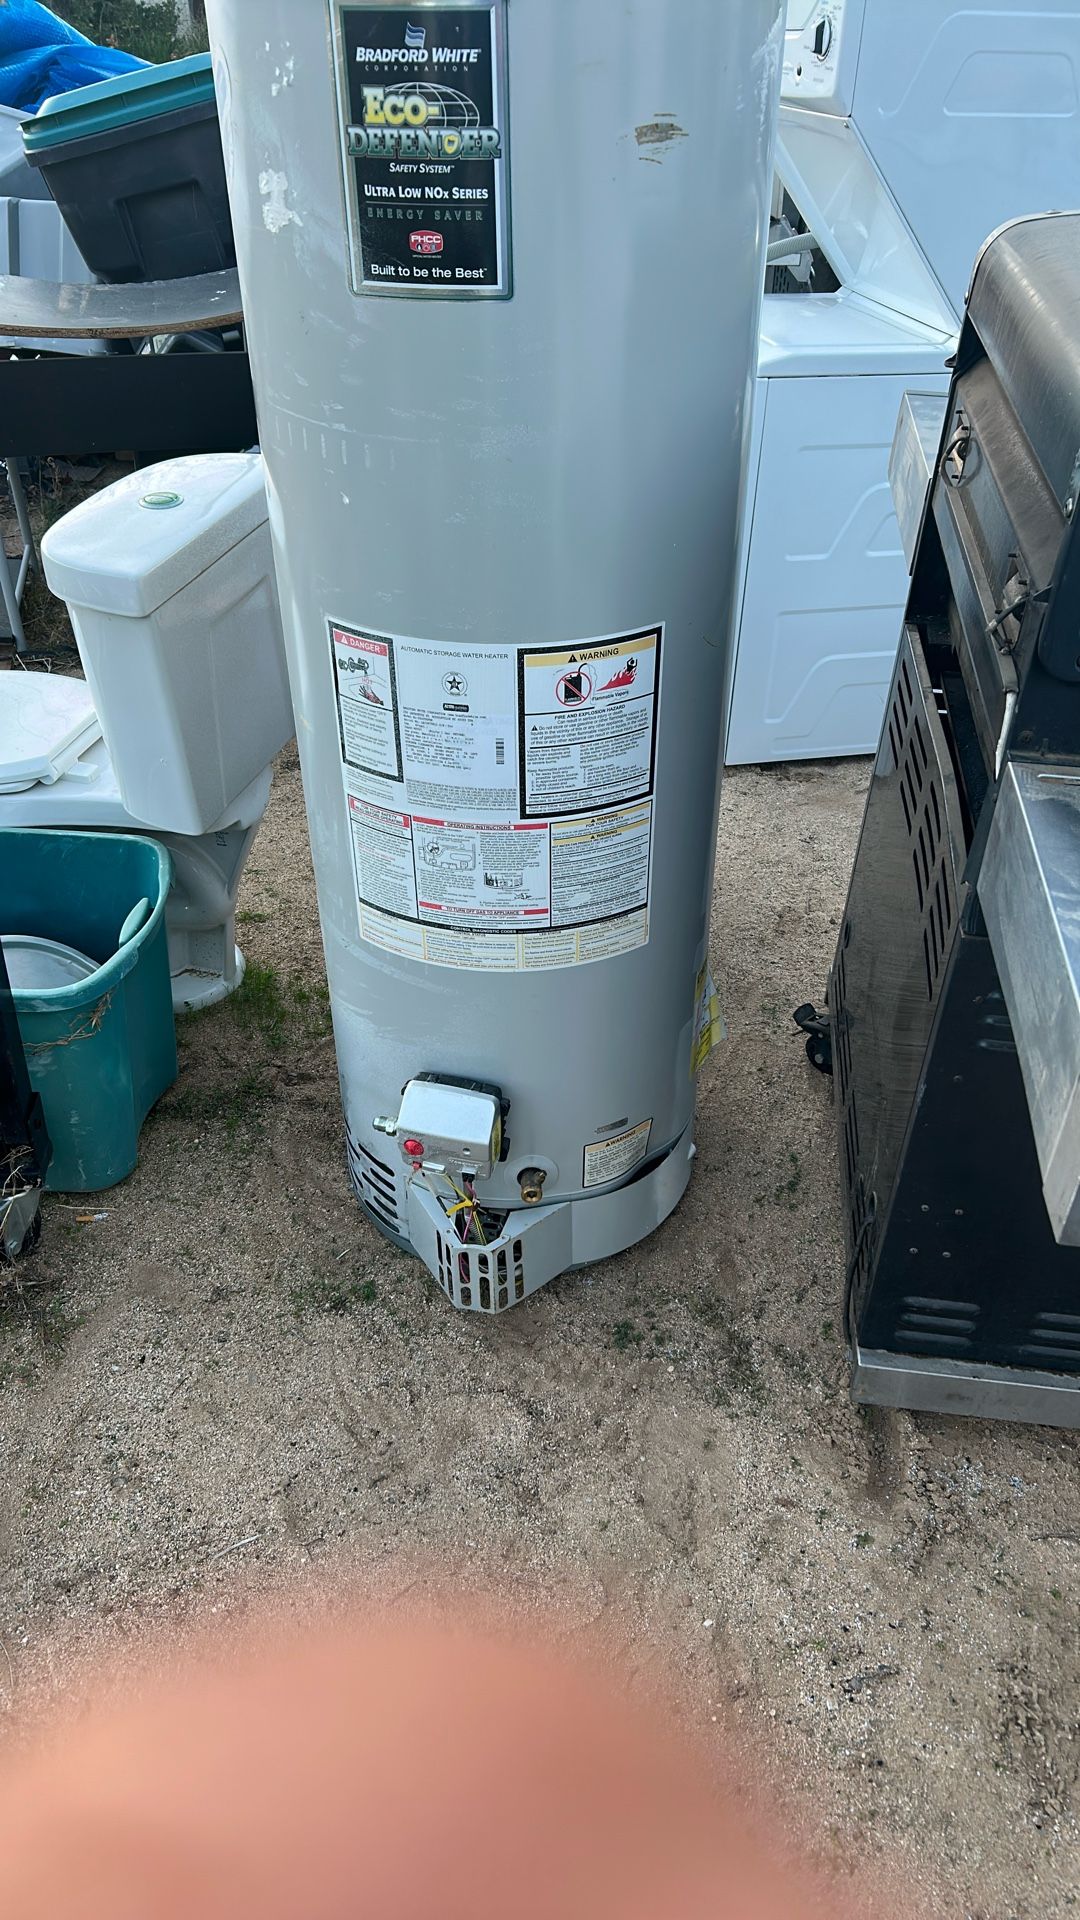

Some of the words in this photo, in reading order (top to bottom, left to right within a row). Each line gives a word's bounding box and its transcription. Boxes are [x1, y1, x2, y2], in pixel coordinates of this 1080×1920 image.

[355, 46, 428, 63] BRADFORD
[347, 126, 501, 160] DEFENDER
[389, 162, 418, 174] SAFETY
[364, 184, 396, 198] ULTRA
[398, 185, 422, 199] LOW
[452, 187, 488, 200] SERIES
[367, 207, 424, 220] ENERGY
[434, 209, 483, 221] SAVER
[411, 235, 441, 244] PHCC
[371, 264, 395, 276] Built
[398, 266, 410, 277] to
[413, 267, 429, 278] be
[432, 267, 452, 278] the
[350, 638, 380, 653] DANGER
[401, 645, 433, 656] AUTOMATIC
[433, 650, 461, 658] STORAGE
[579, 648, 619, 661] WARNING
[579, 709, 606, 717] EXPLOSION
[596, 813, 618, 822] WARNING
[447, 822, 474, 830] OPERATING
[597, 829, 617, 838] WARNING
[610, 1130, 636, 1145] WARNING
